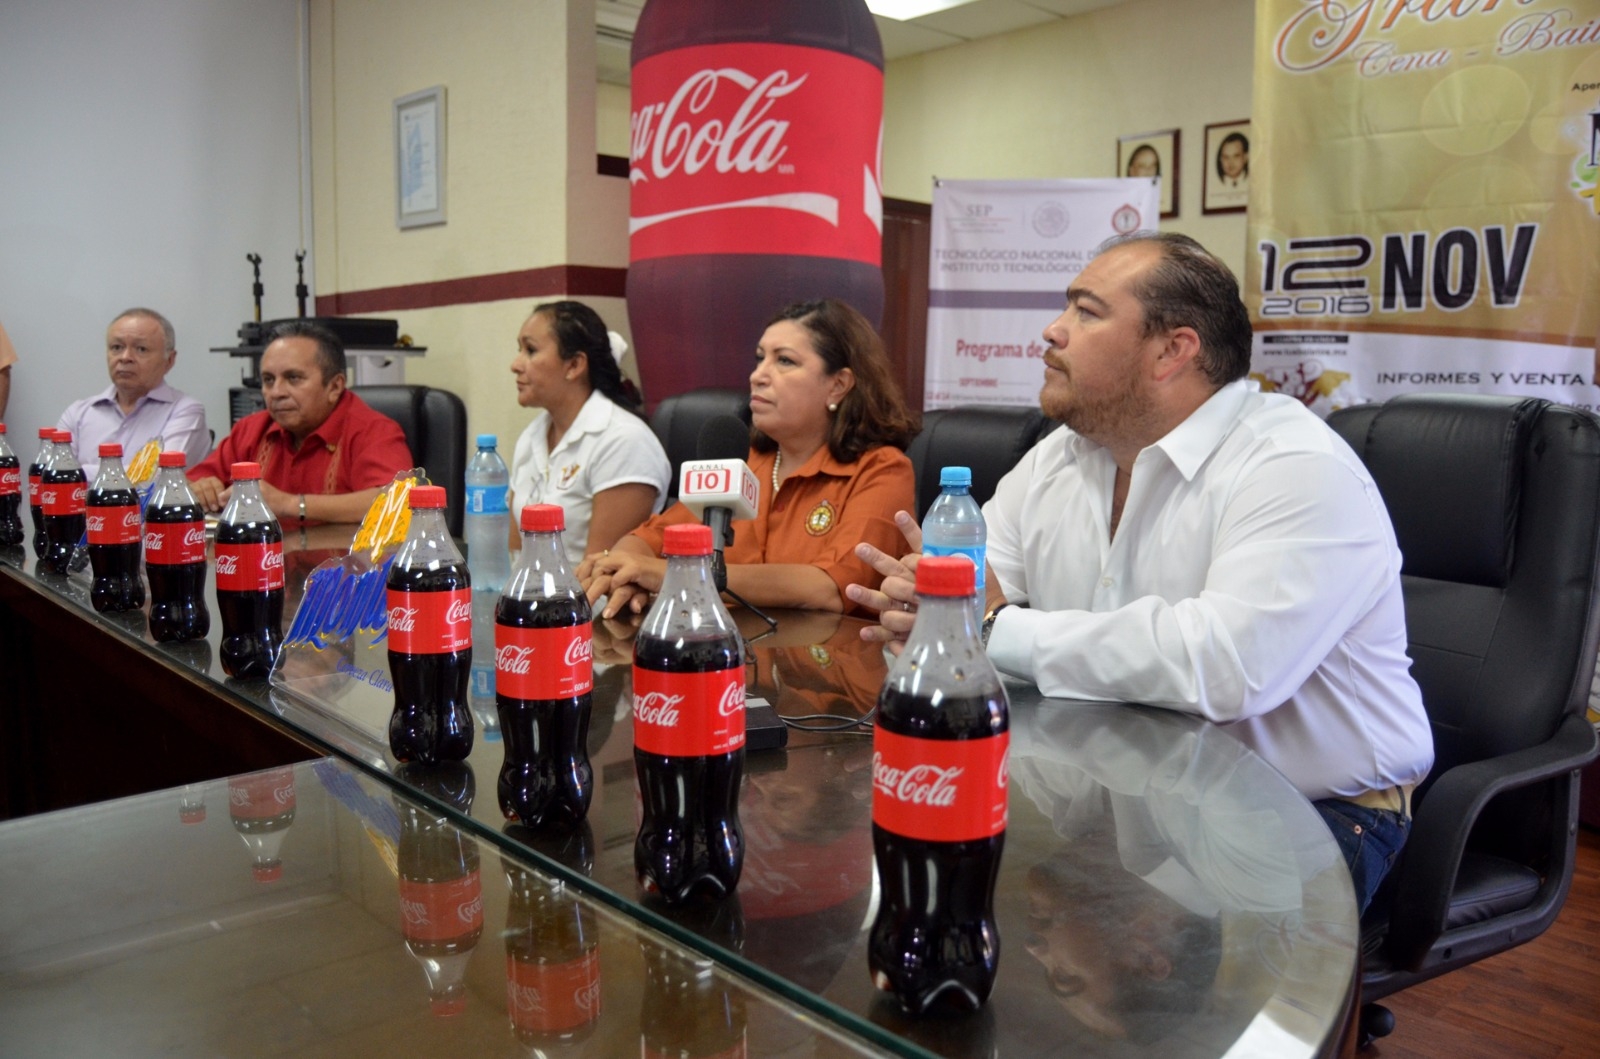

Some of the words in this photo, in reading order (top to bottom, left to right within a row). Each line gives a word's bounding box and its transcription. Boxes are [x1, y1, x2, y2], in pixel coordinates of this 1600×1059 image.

[1352, 40, 1452, 78] Cena
[966, 204, 993, 217] SEP
[1021, 249, 1083, 261] NACIONAL
[941, 261, 1000, 273] INSTITUTO
[1260, 236, 1371, 292] 12
[1382, 224, 1536, 310] NOV
[1261, 296, 1370, 316] 2016
[956, 339, 1023, 362] Programa
[1026, 340, 1043, 358] de
[1377, 372, 1481, 384] INFORMES
[1490, 372, 1504, 384] Y
[1510, 373, 1585, 386] VENTA
[692, 463, 724, 471] CANAL
[574, 682, 584, 692] 600
